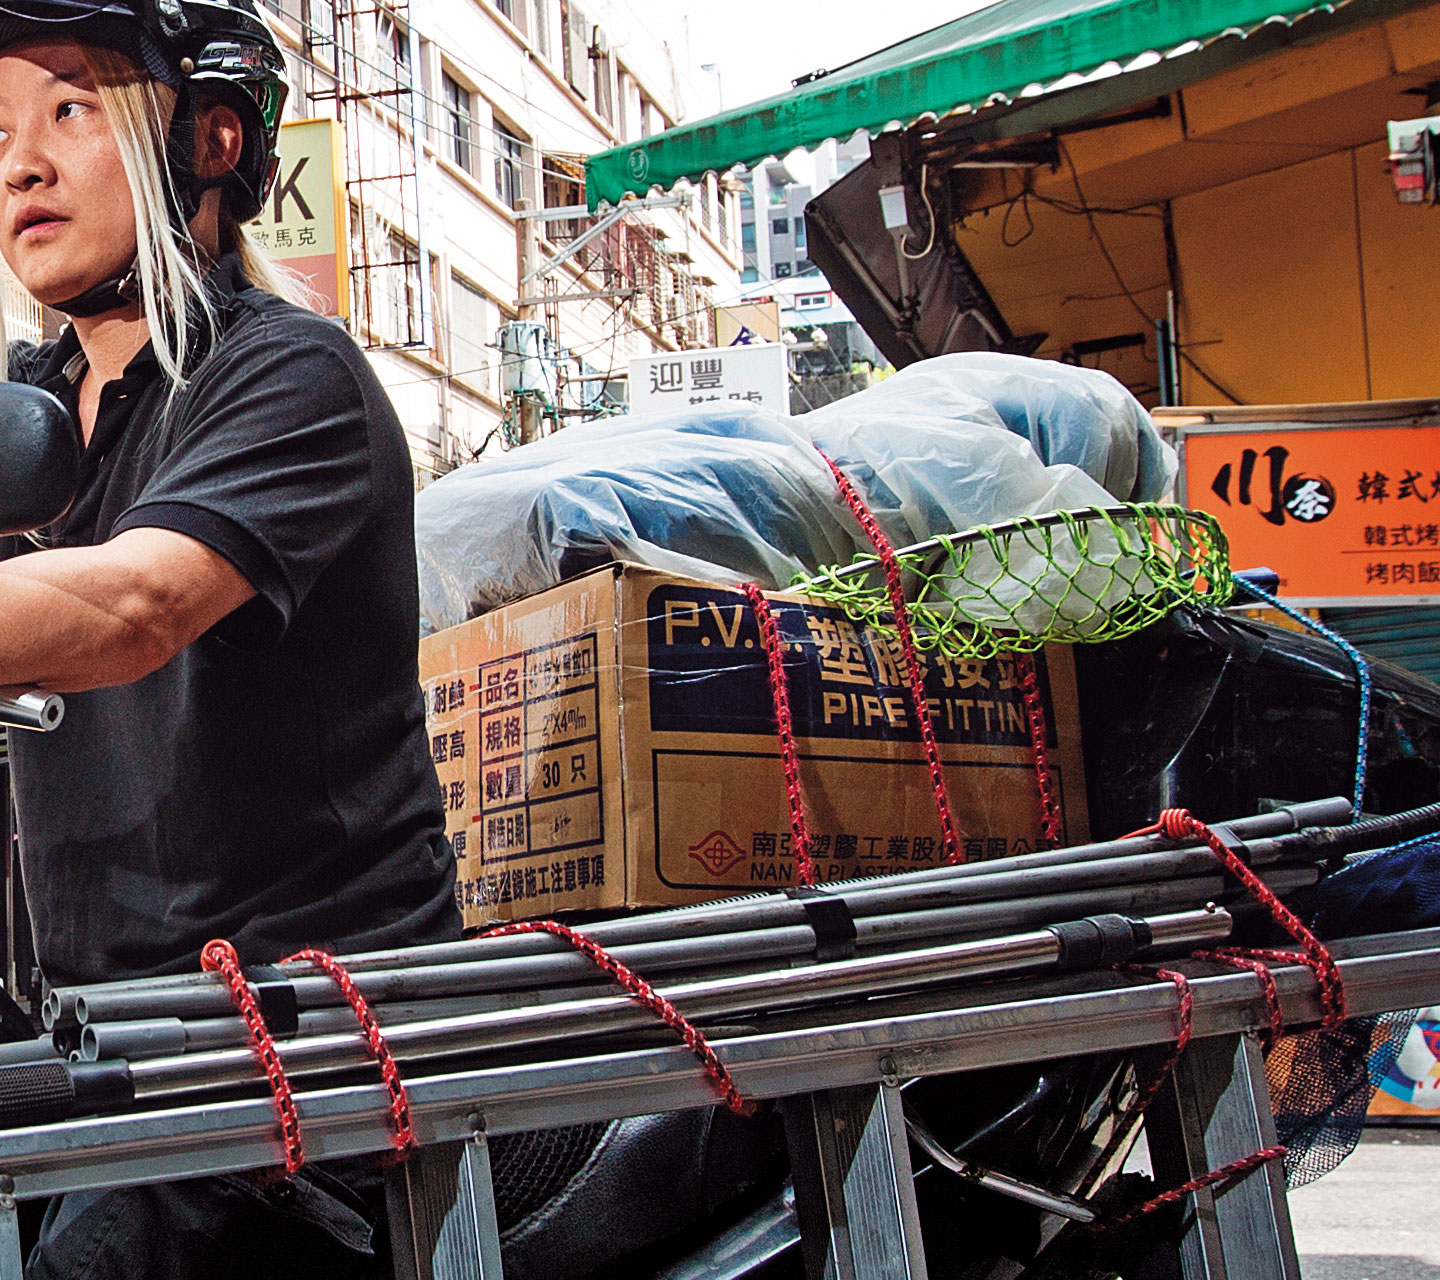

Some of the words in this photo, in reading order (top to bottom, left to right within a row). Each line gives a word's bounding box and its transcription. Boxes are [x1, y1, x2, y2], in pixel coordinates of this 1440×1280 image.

[649, 358, 724, 395] 迎豐
[425, 678, 466, 717] 耐鹼
[486, 667, 520, 705] 品名
[822, 692, 909, 729] PIPE
[927, 698, 1028, 734] FITTIN
[485, 715, 521, 752] 規格
[486, 765, 523, 802] 數量
[542, 760, 561, 789] 30
[571, 753, 588, 783] 只
[487, 813, 525, 851] 製造日期
[750, 862, 794, 881] NAN
